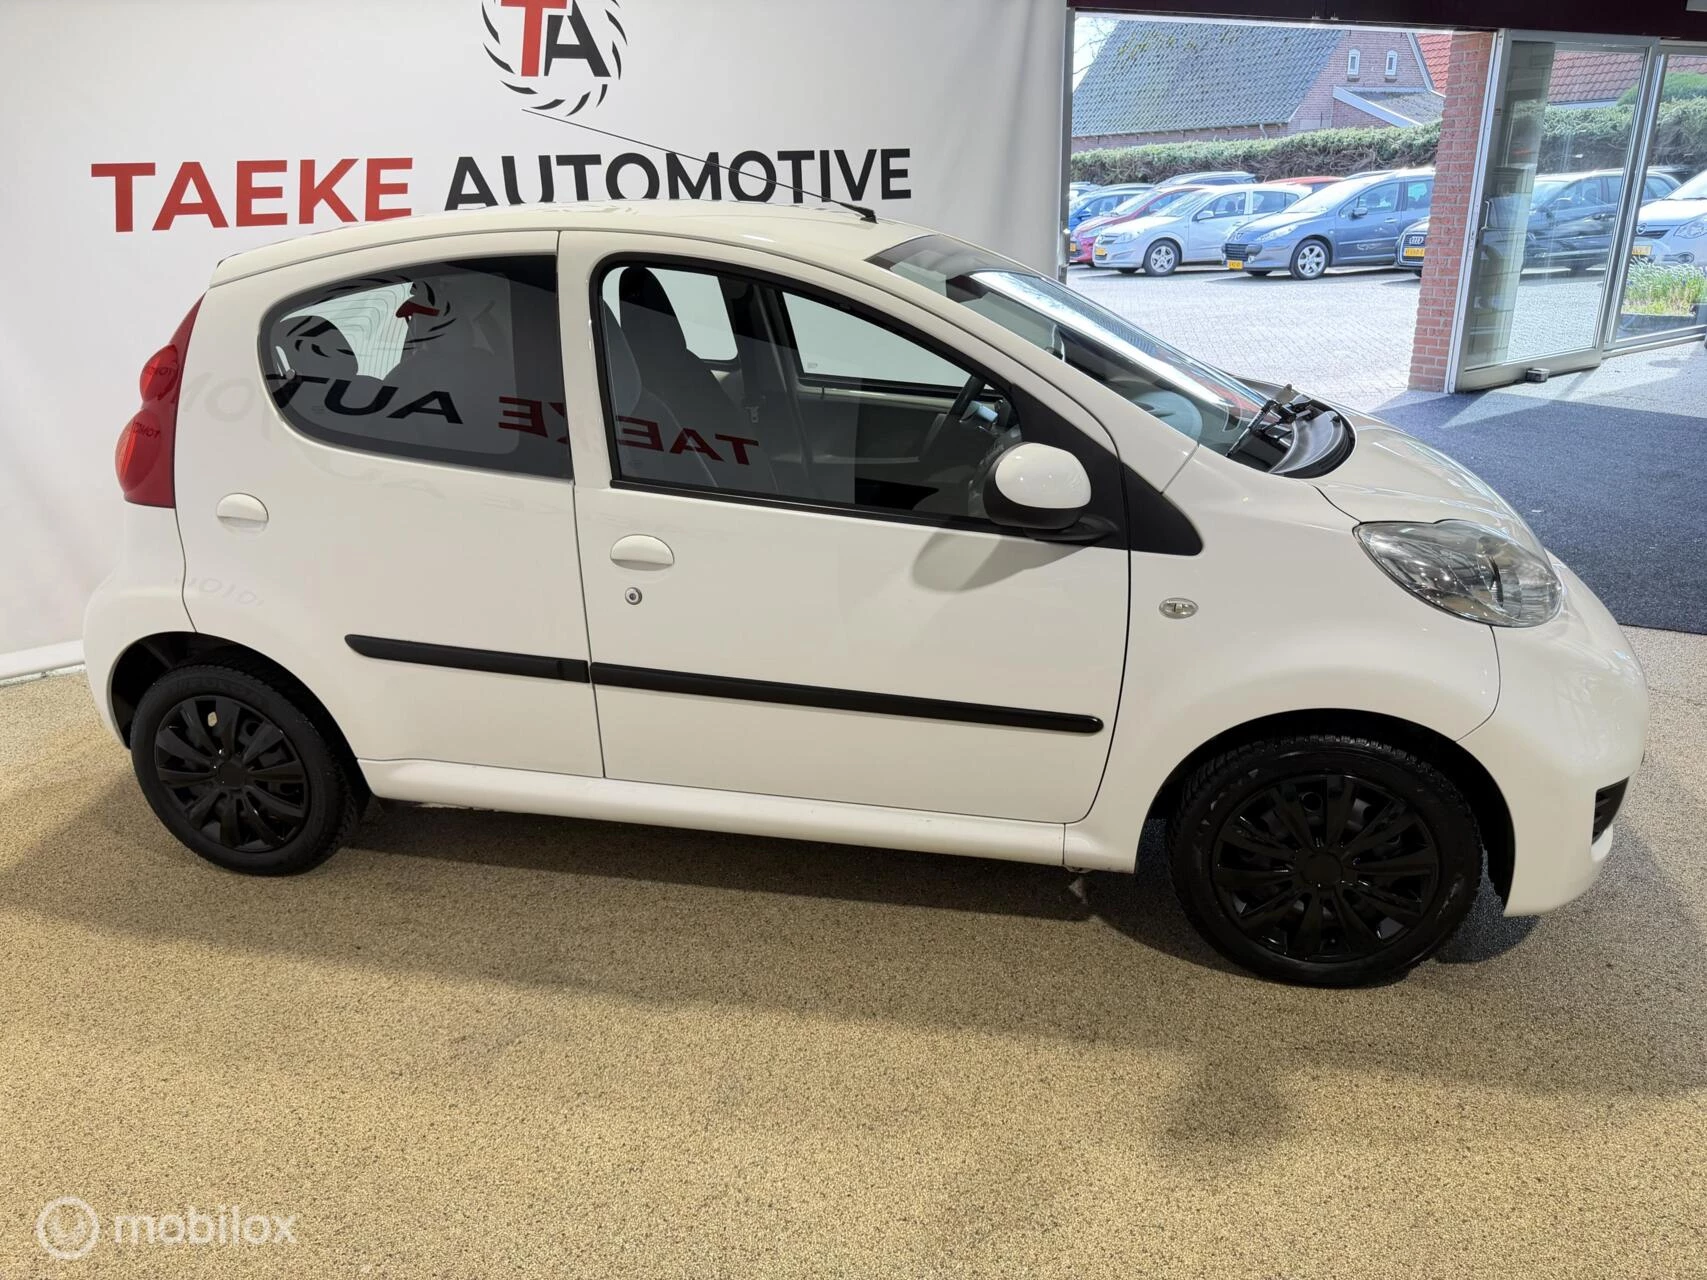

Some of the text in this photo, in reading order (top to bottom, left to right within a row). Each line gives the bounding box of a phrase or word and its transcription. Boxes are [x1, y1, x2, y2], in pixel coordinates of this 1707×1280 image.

[499, 0, 612, 78] TA
[91, 148, 912, 232] TAEKE AUTOMOTIVE
